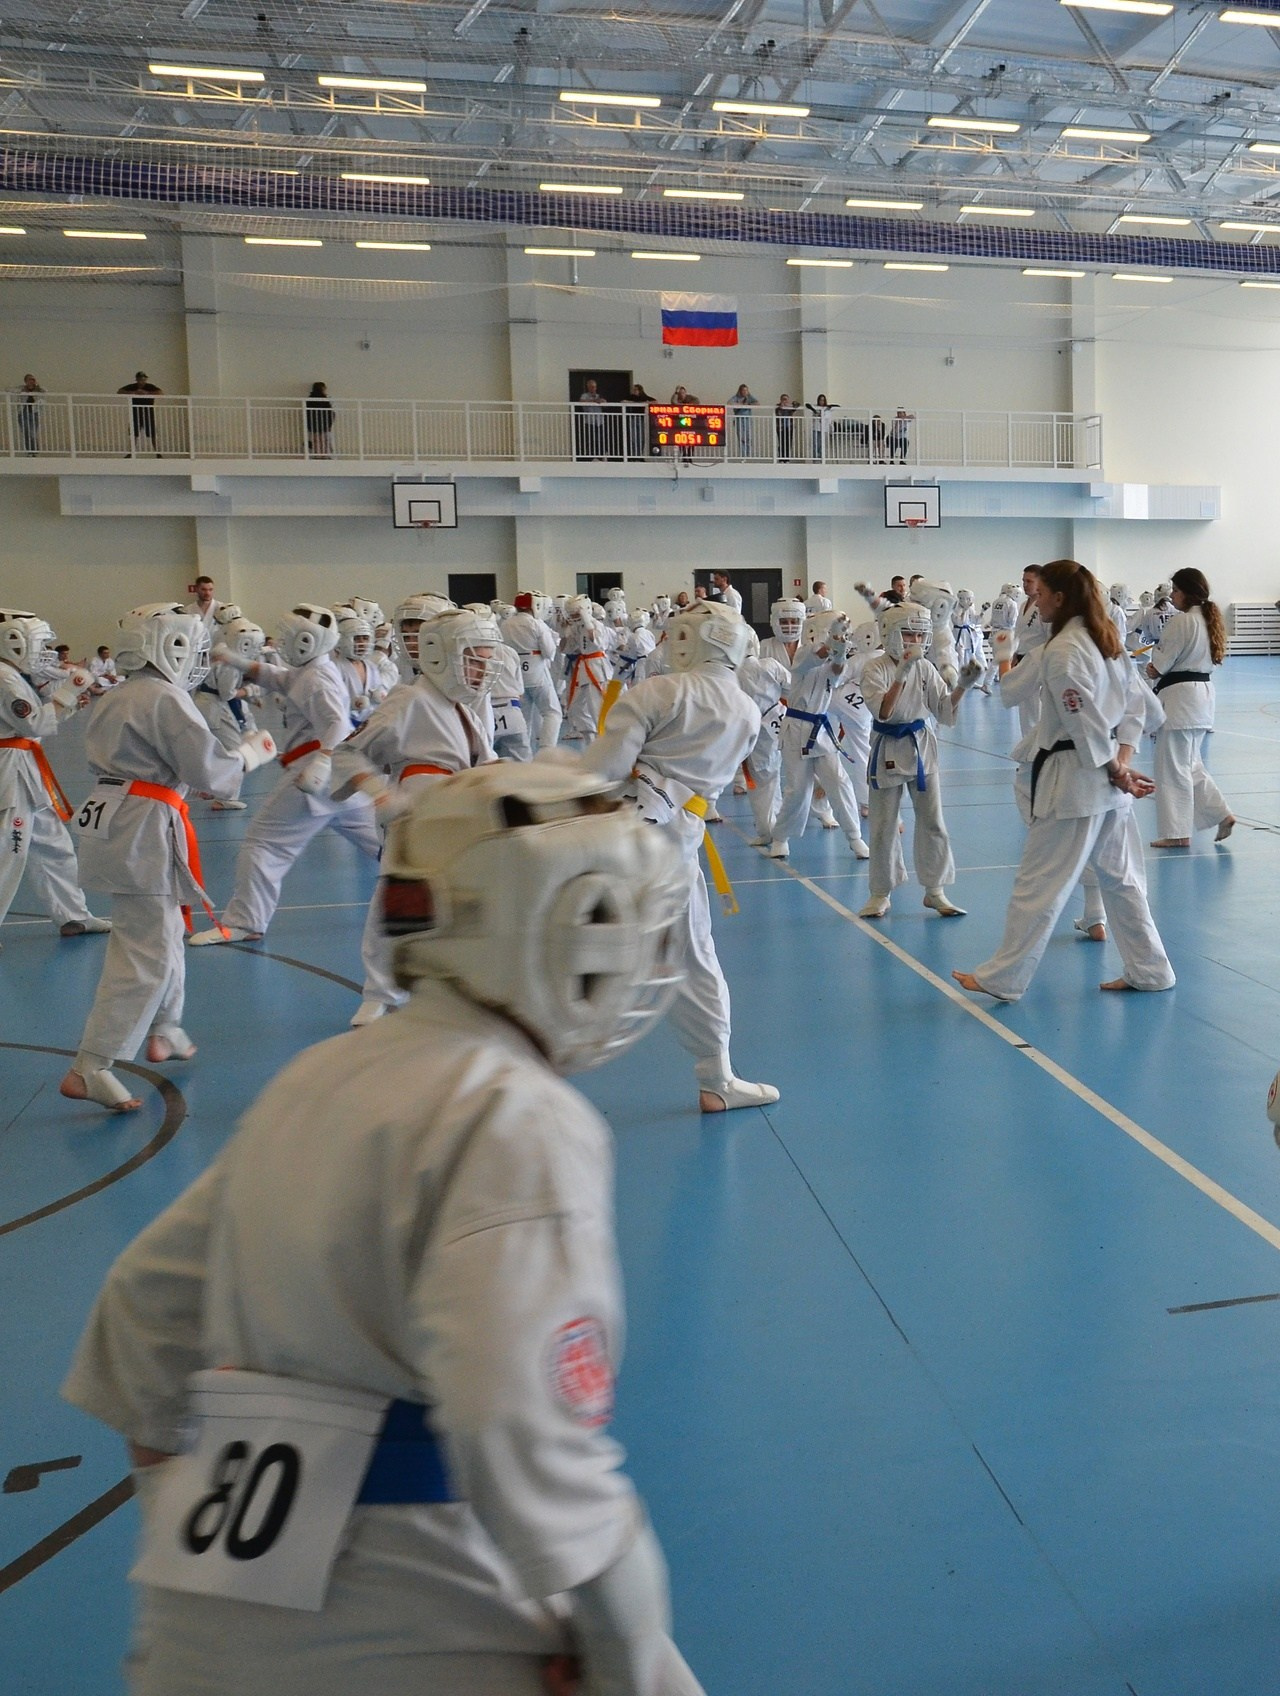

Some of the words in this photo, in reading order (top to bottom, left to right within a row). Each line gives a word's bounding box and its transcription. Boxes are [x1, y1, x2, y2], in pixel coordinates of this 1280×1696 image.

[708, 418, 722, 429] 59
[659, 433, 667, 444] 0
[708, 434, 717, 445] 0
[844, 692, 865, 710] 42
[78, 800, 107, 830] 51
